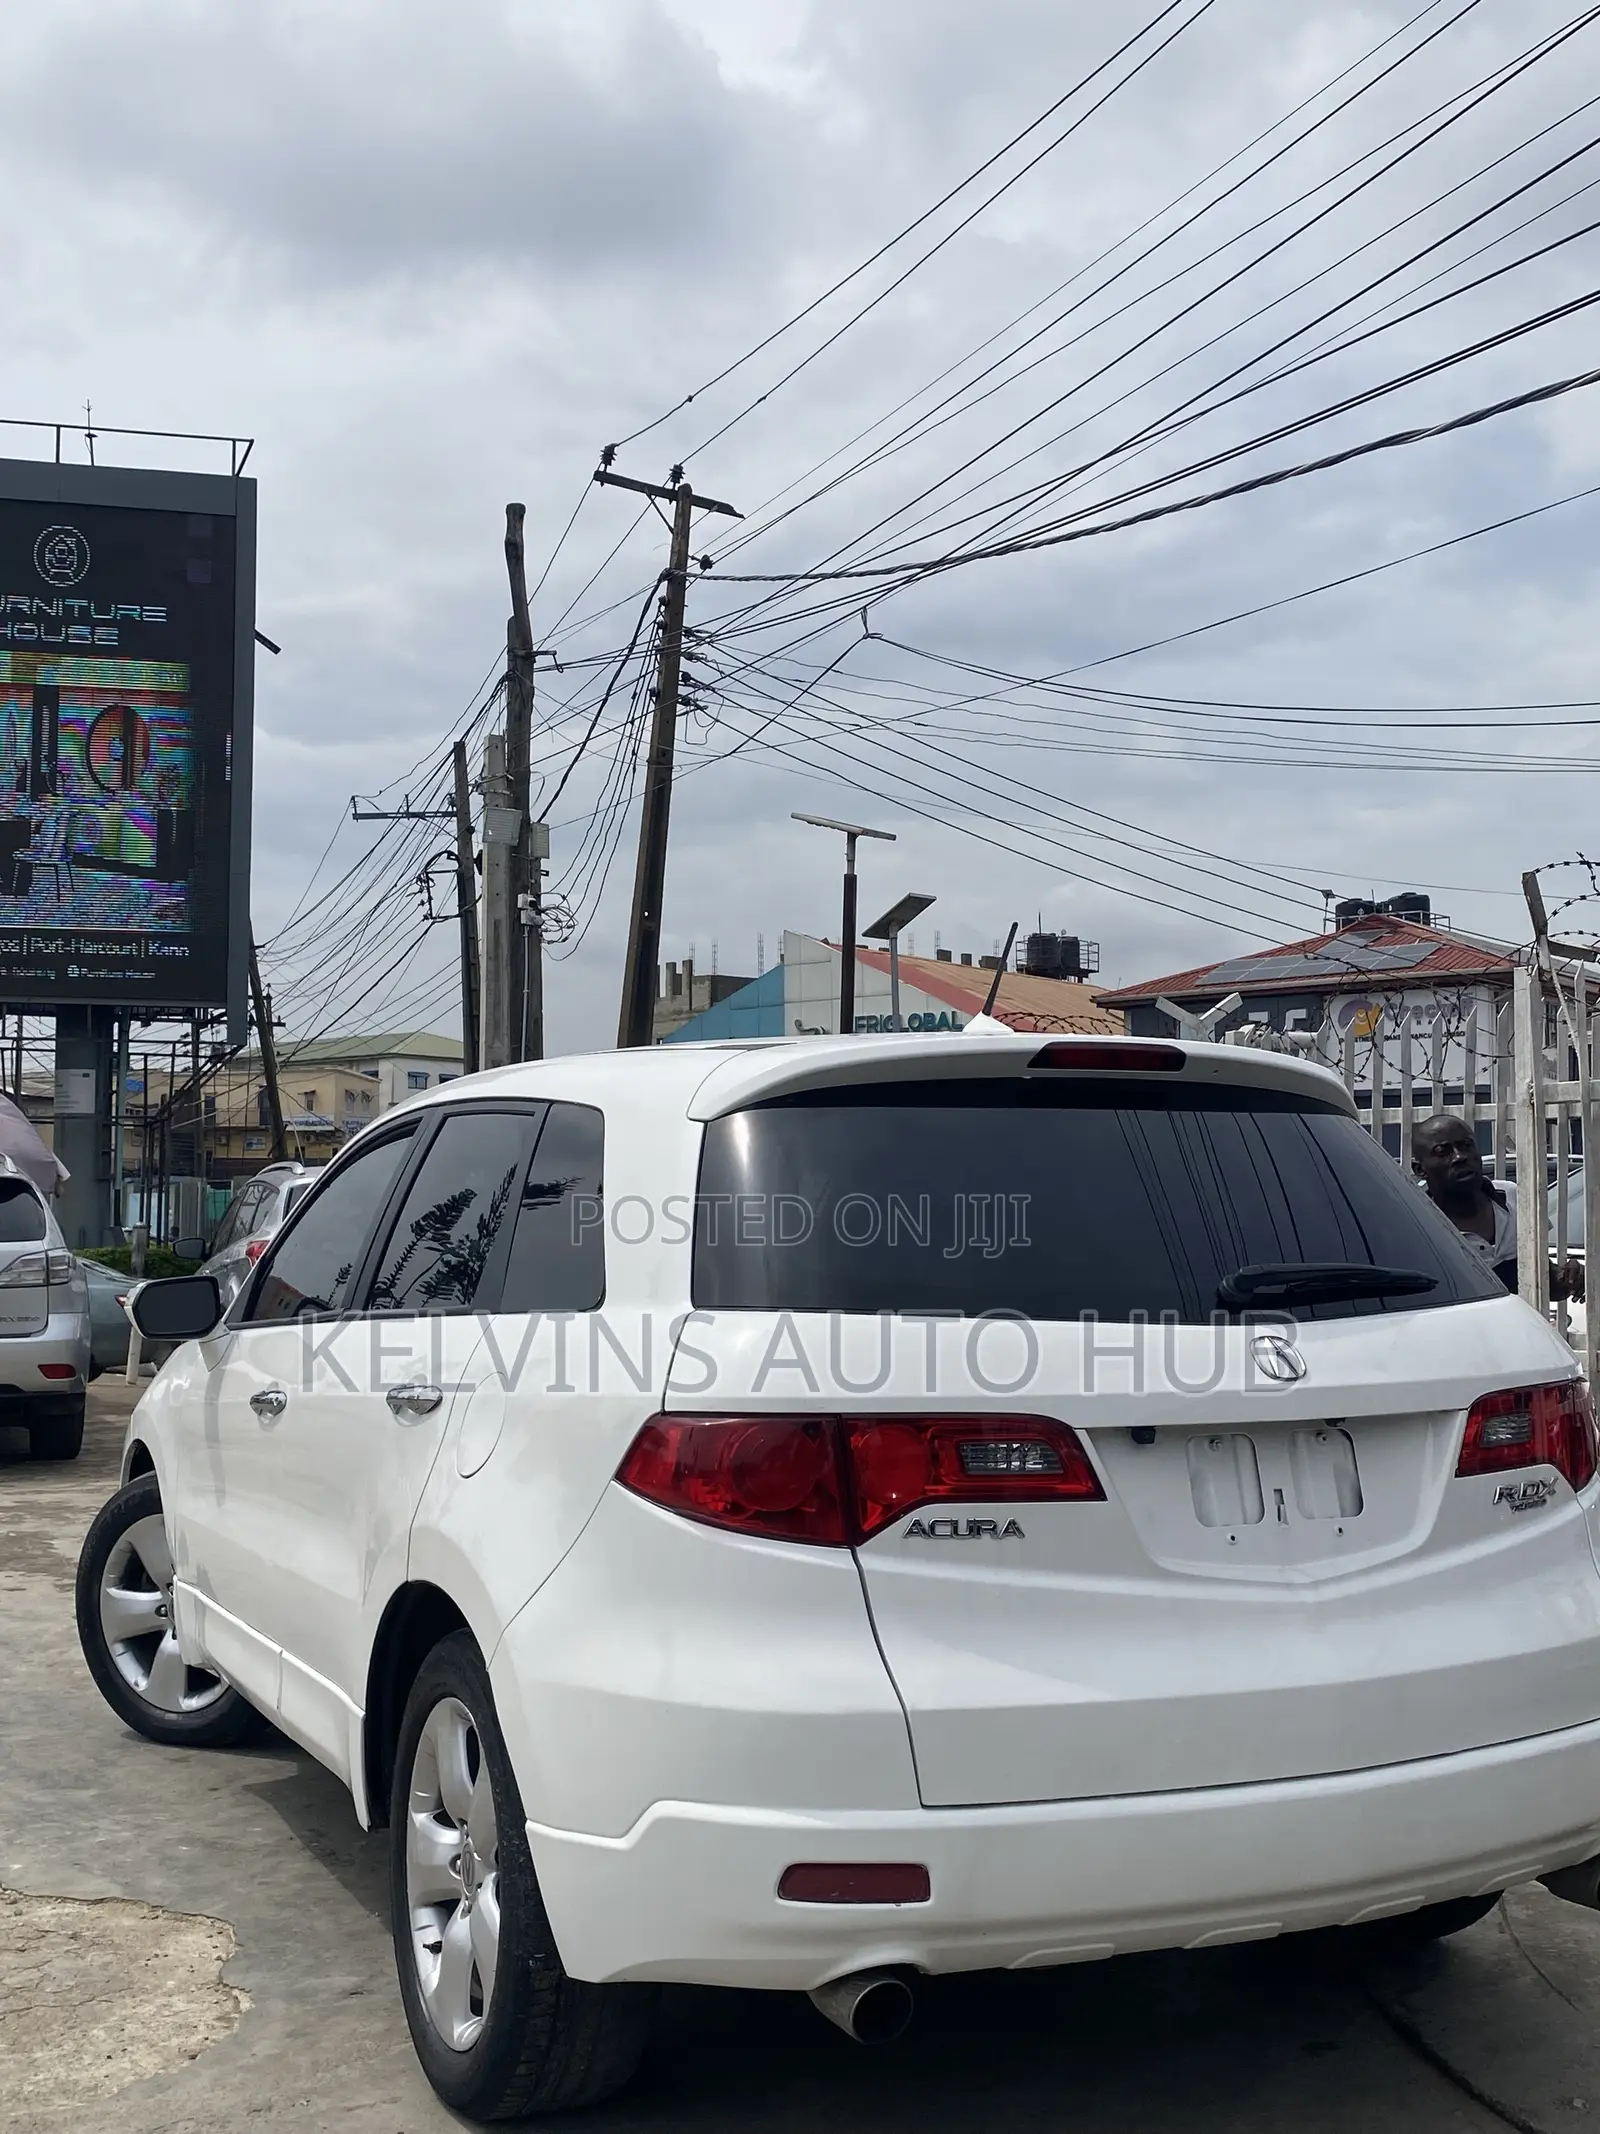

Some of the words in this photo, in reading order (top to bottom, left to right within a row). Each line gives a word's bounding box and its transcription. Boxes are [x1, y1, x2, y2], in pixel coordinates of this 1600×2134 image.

[0, 594, 167, 622] RNITURE
[1493, 1476, 1559, 1505] RDX
[902, 1517, 1026, 1540] ACURA
